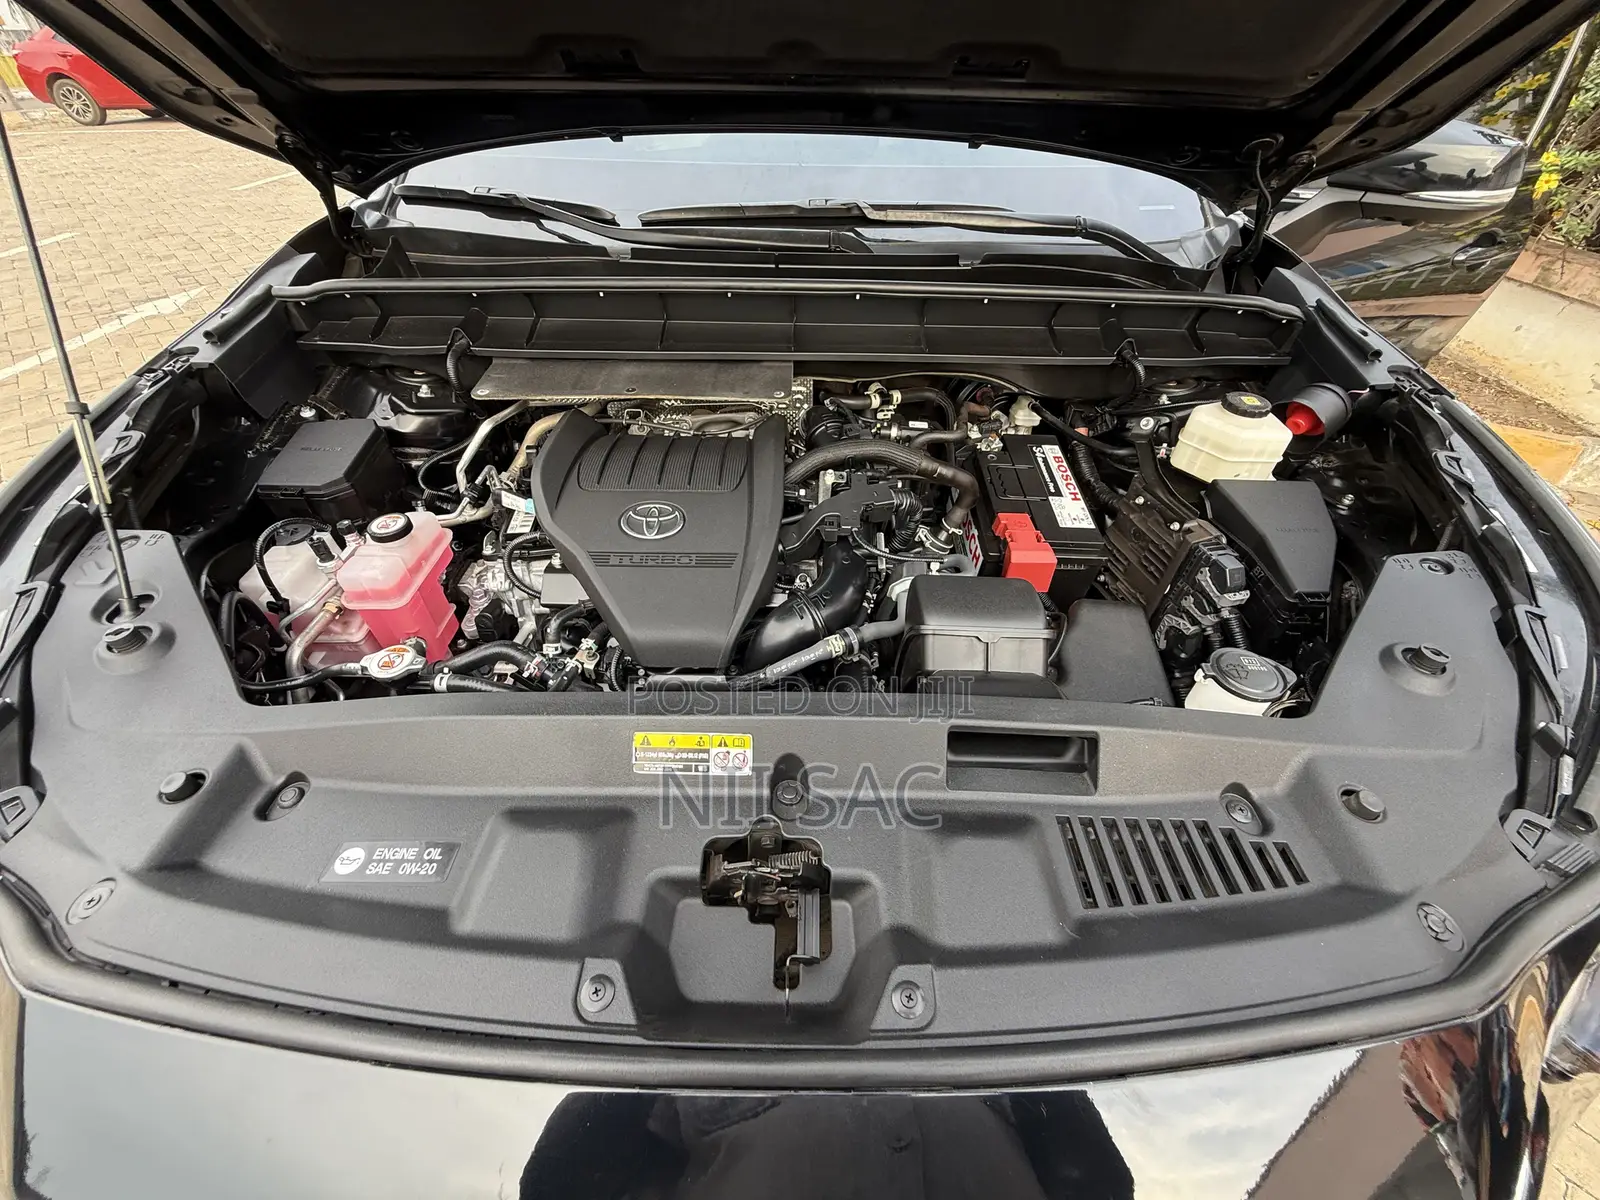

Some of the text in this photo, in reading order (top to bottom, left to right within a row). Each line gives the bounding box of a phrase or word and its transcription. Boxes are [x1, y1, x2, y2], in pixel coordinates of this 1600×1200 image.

[1053, 455, 1081, 502] BOSCH
[611, 553, 695, 566] TURBO
[372, 848, 443, 860] ENGINE OIL
[365, 862, 393, 875] SAE
